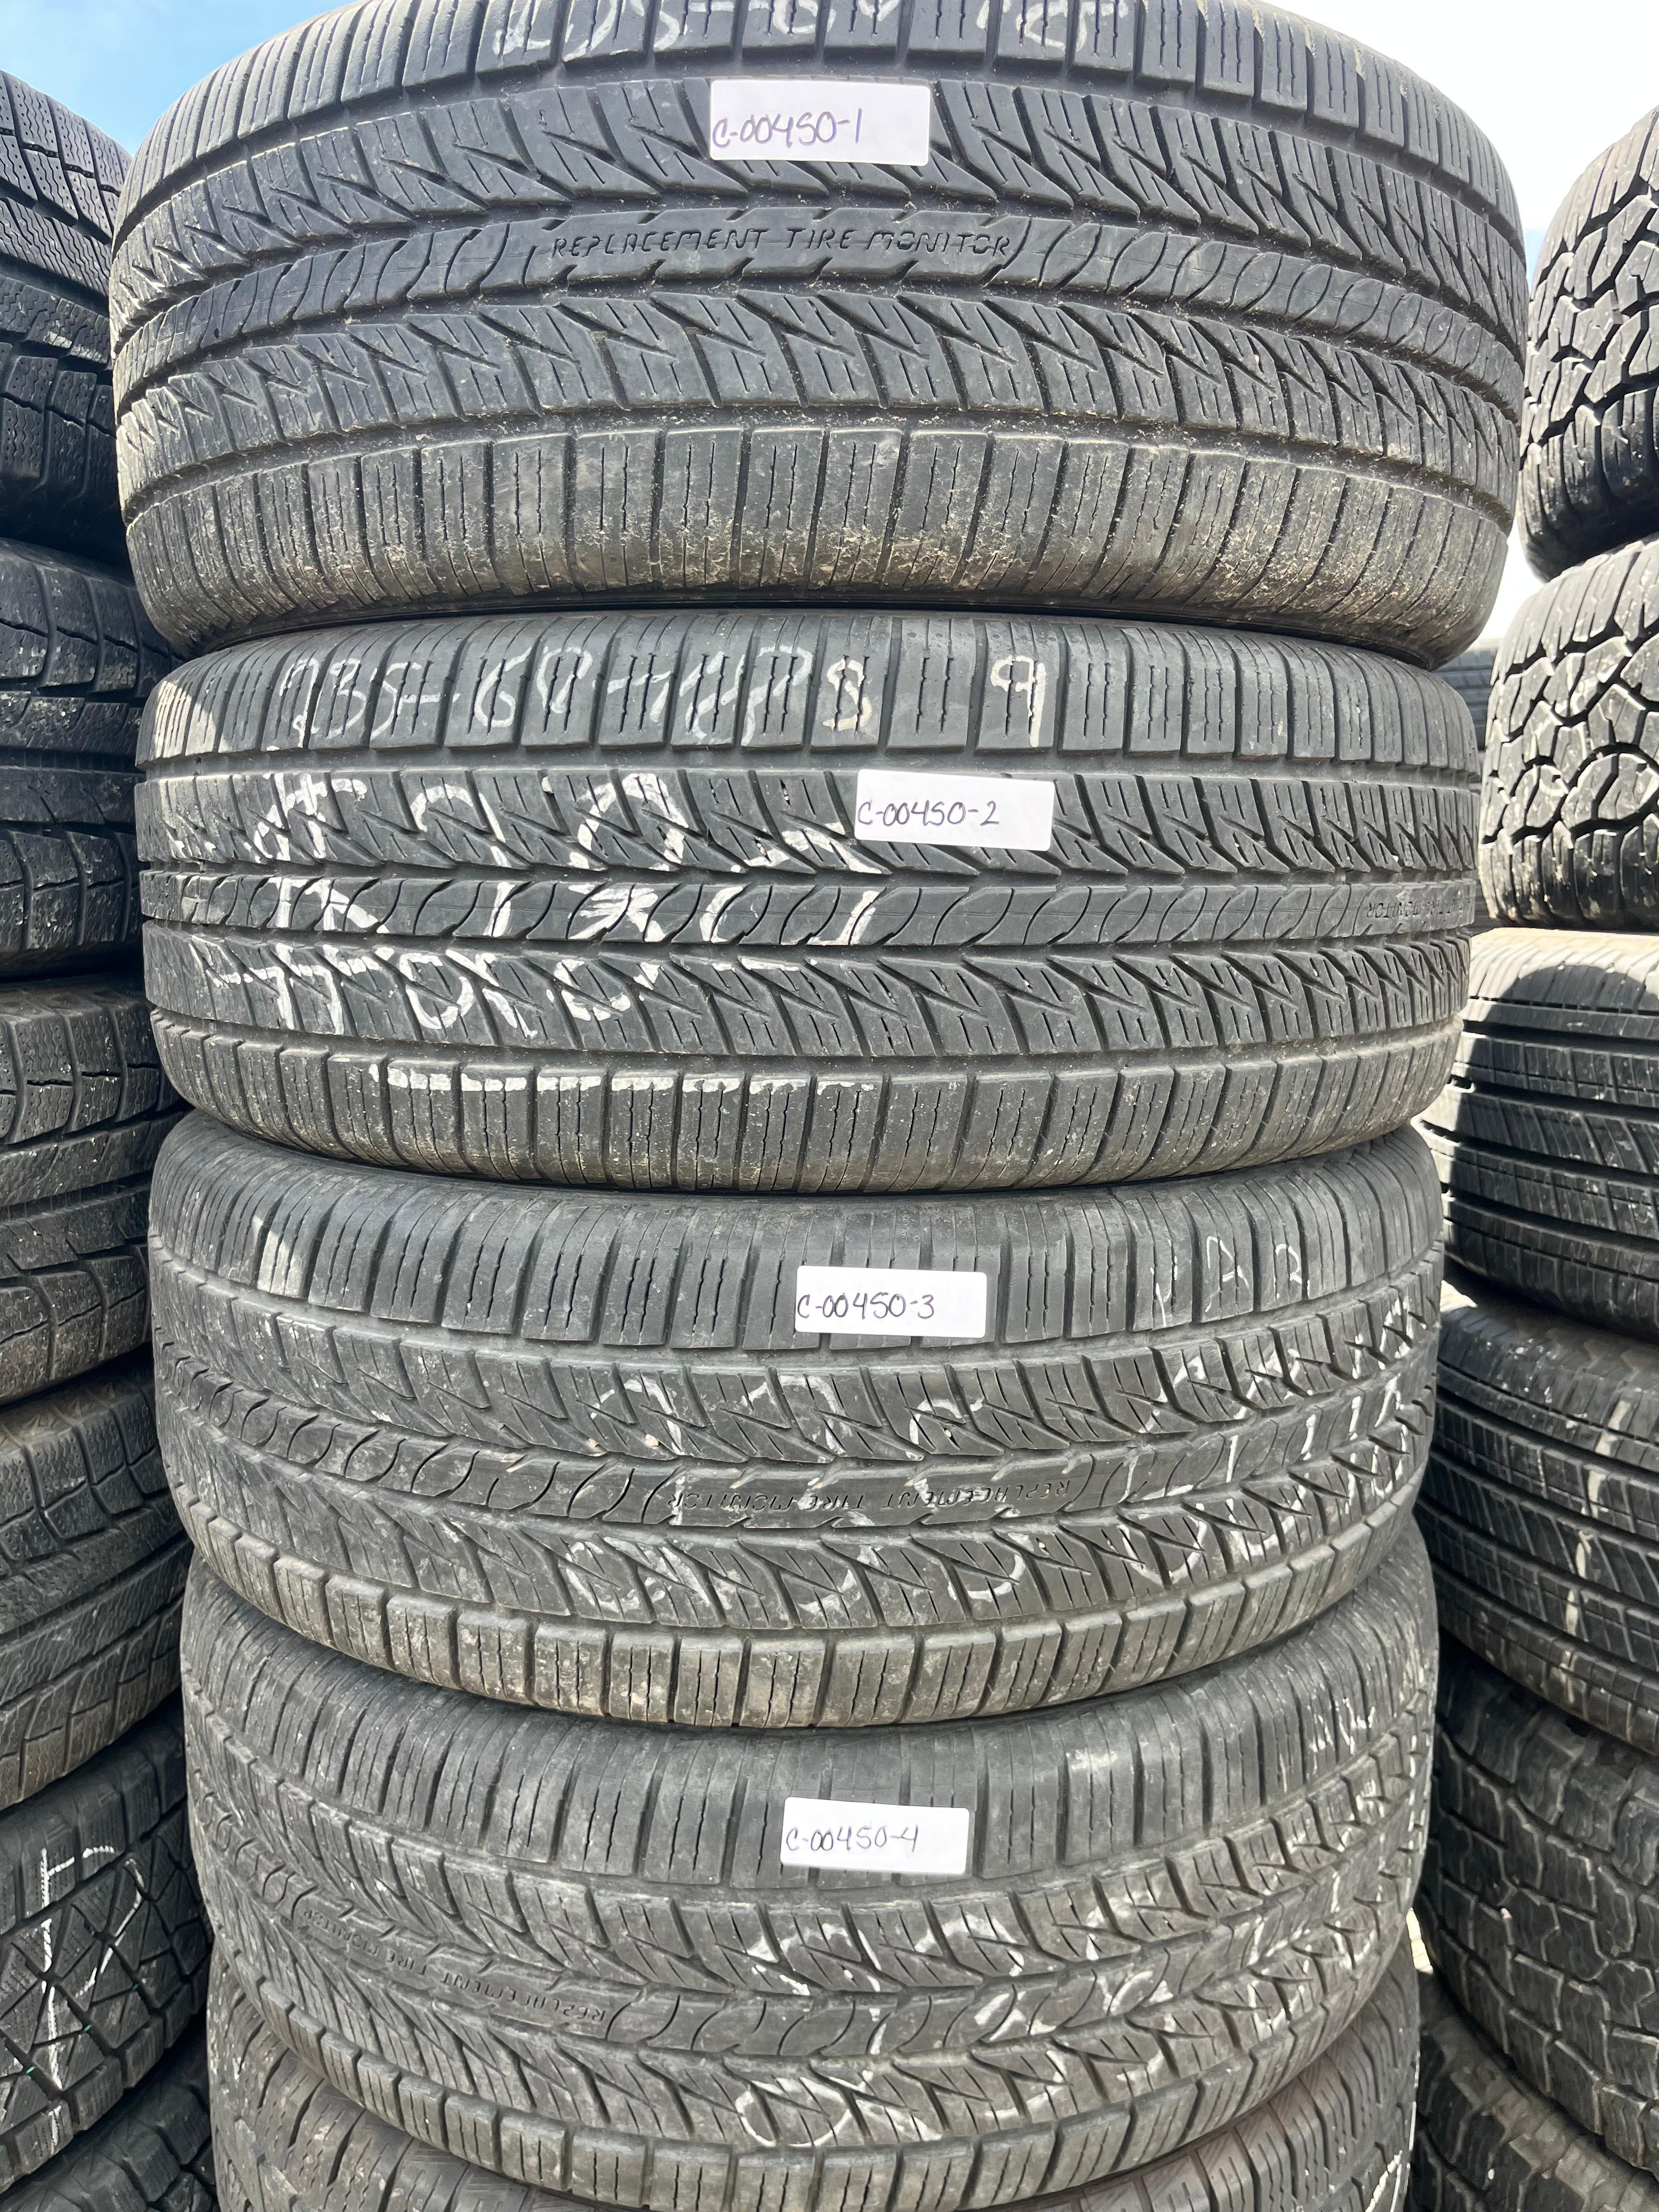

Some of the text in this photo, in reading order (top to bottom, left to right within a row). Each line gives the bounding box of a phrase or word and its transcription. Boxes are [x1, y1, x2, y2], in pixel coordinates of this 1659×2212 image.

[712, 108, 863, 148] C-00450-1
[549, 227, 1010, 259] REPLACEMENT TIRE MONITOR
[858, 799, 1000, 826] C-00450-2
[797, 1292, 934, 1319] C-00450-3
[668, 1480, 1070, 1511] REPLACEMENT TIRE MONITOR
[786, 1824, 918, 1852] C-00450-4
[440, 1972, 606, 2022] REPLACEMENT
